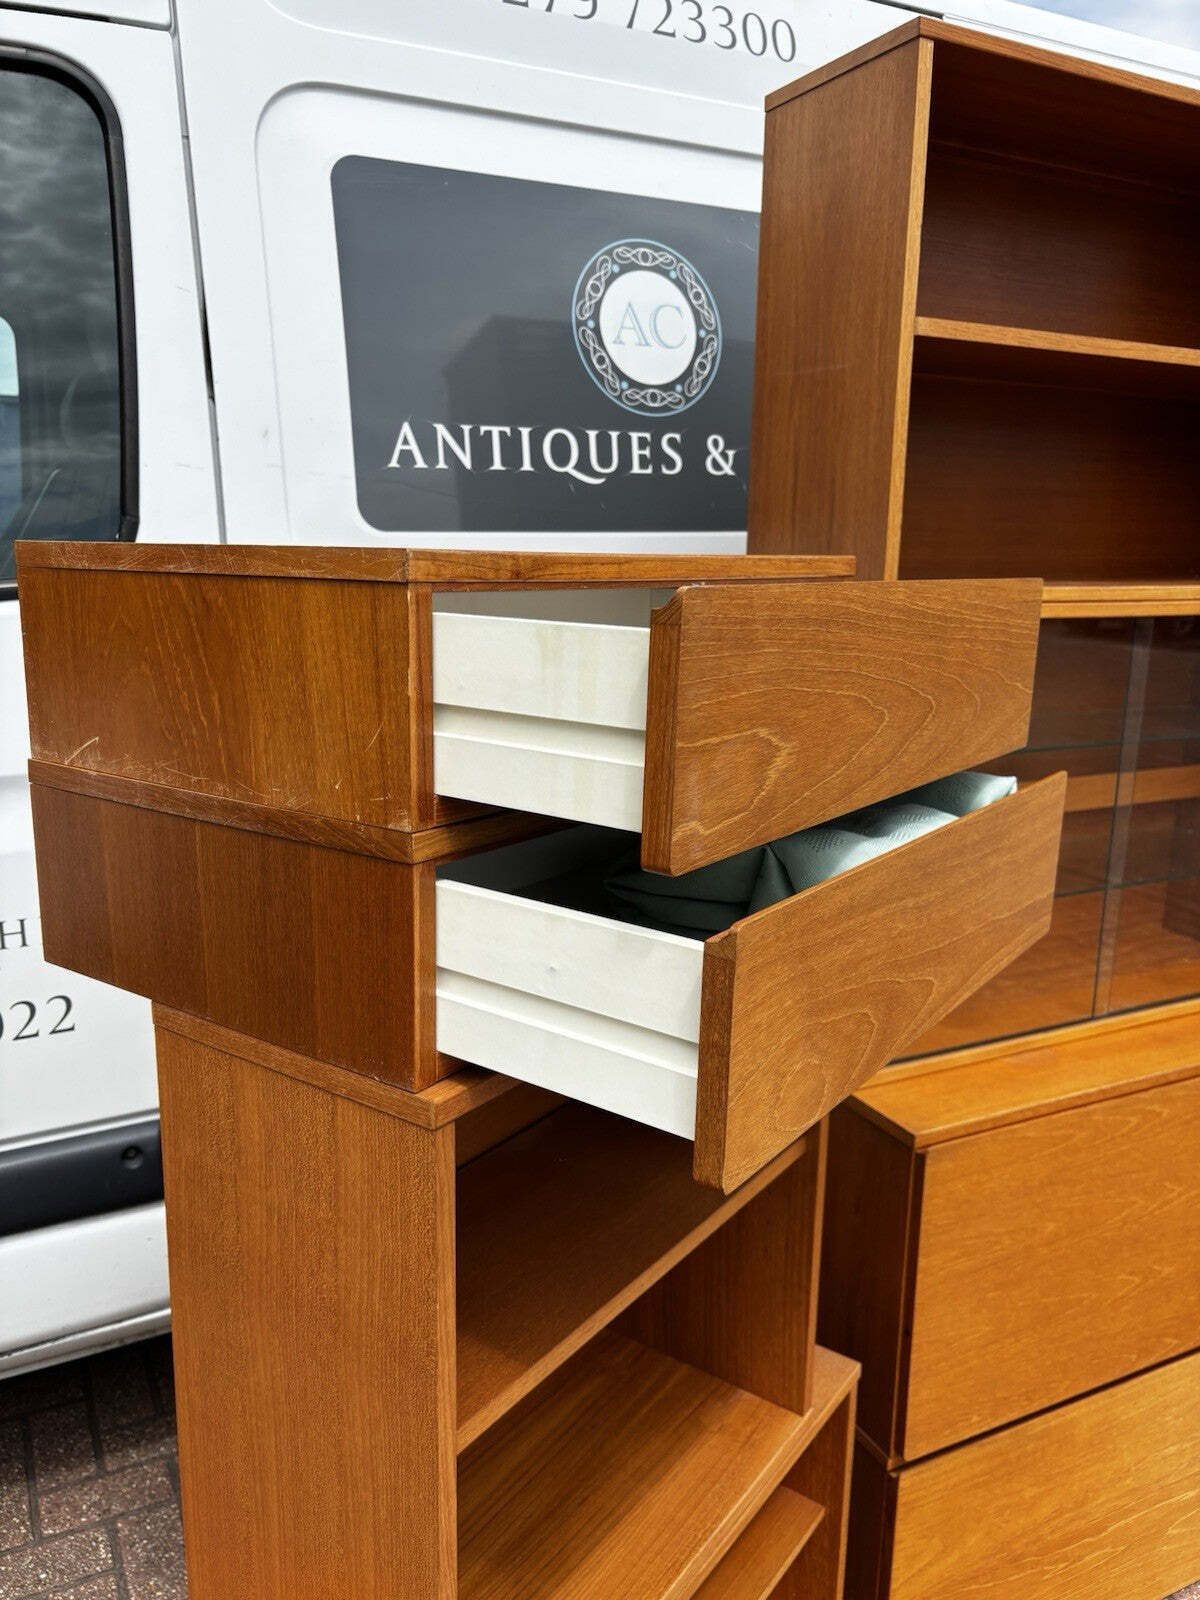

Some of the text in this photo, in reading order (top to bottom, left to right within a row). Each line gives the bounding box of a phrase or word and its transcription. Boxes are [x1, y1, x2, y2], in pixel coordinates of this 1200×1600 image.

[612, 302, 687, 350] AC
[387, 419, 737, 485] ANTIQUES &
